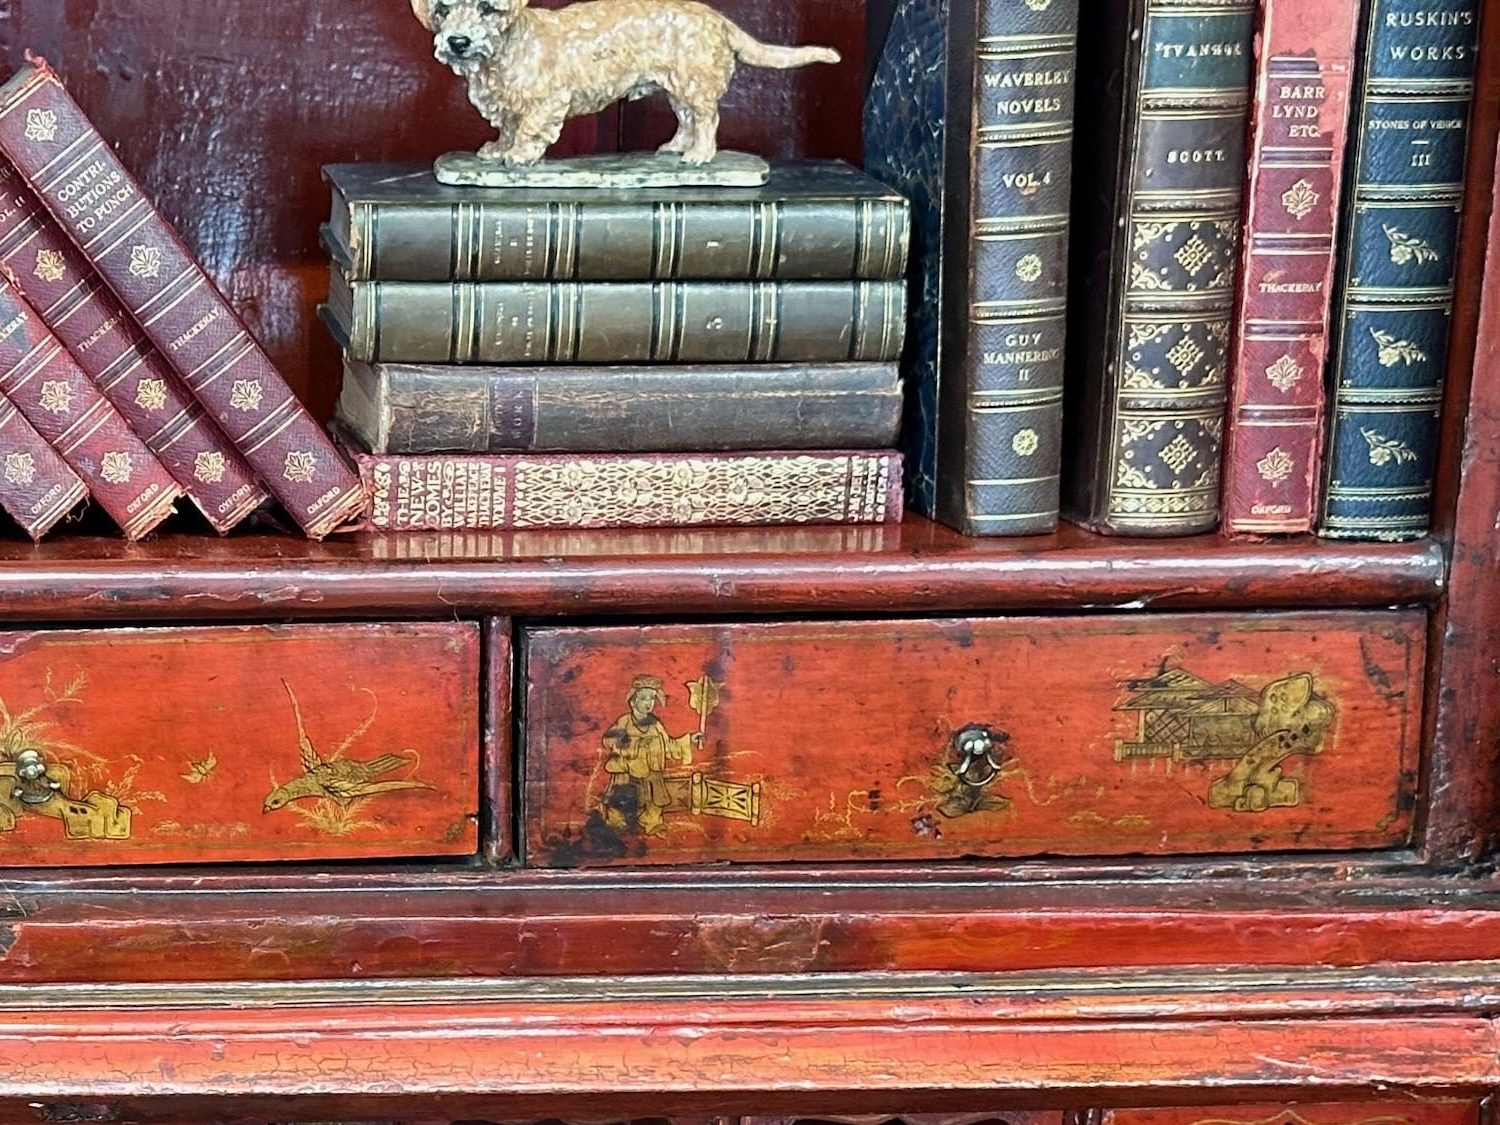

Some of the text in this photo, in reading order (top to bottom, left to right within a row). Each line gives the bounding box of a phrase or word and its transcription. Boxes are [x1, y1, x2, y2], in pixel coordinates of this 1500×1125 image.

[1386, 11, 1473, 27] RUSKIN'S
[1390, 46, 1466, 61] WORKS
[984, 69, 1072, 88] WAVERLEY
[996, 98, 1061, 115] NOVELS
[1367, 119, 1409, 129] STONES
[1412, 119, 1427, 129] OF
[1411, 154, 1431, 167] III
[1002, 171, 1052, 188] VOL. 4
[65, 170, 121, 219] BUTIONS
[75, 184, 134, 233] TO PUNCH
[1259, 280, 1323, 294] THACKERAY
[77, 310, 124, 353] THACKERAY
[170, 307, 221, 351] THACKERAY
[1005, 331, 1043, 347] GUY
[983, 347, 1060, 365] MANNERING
[1018, 368, 1031, 381] II
[30, 483, 63, 515] OXFORD
[126, 483, 159, 514] OXFORD
[218, 483, 251, 514] OXFORD
[306, 486, 341, 514] OXFORD
[425, 461, 441, 527] COMES
[453, 462, 468, 528] WILLIAM
[397, 487, 409, 525] THE
[441, 504, 453, 528] BY
[1250, 503, 1292, 515] OXFORD
